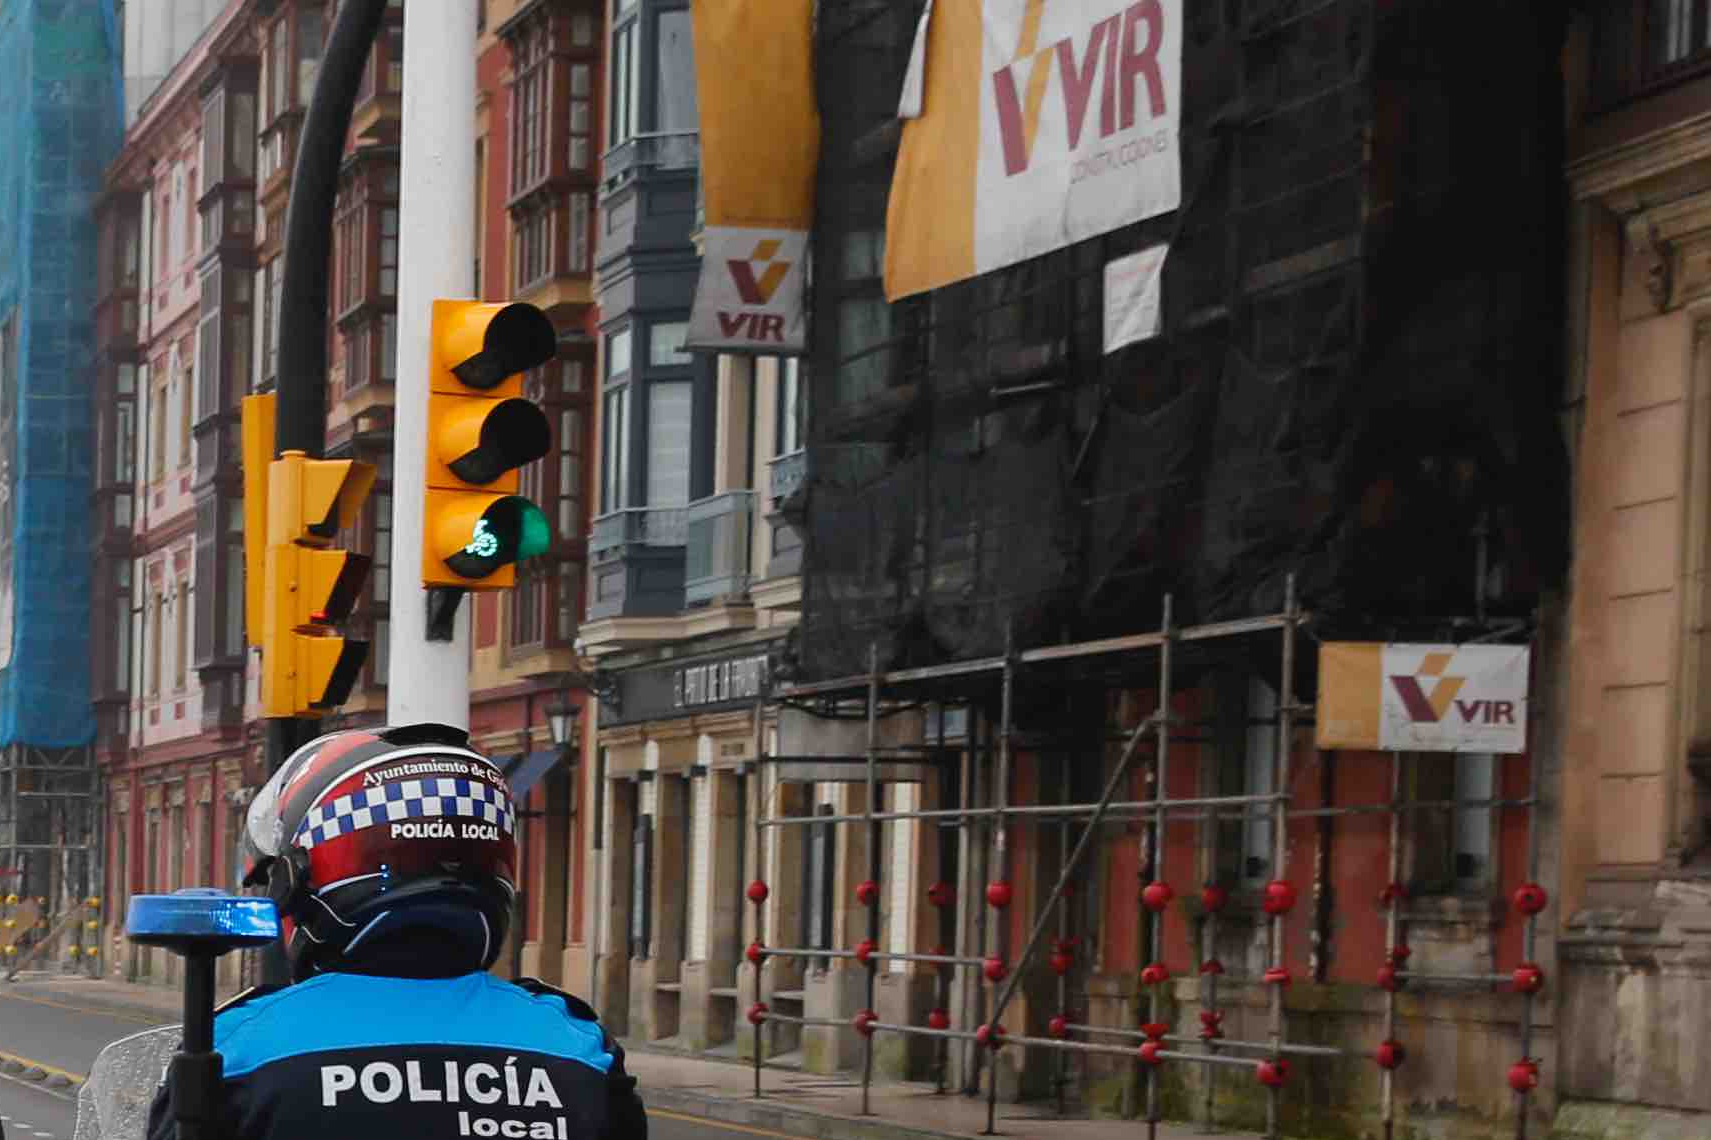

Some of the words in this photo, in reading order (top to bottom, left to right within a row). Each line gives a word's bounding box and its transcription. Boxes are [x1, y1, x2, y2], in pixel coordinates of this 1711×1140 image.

[1056, 0, 1166, 152] VIR
[717, 311, 785, 342] VIR
[1455, 700, 1515, 724] VIR
[362, 759, 469, 787] Ayuntamiento
[470, 763, 486, 778] de
[391, 818, 455, 839] POLICÍA
[461, 823, 500, 841] LOCAL
[321, 1056, 564, 1109] POLICÍA
[458, 1111, 569, 1140] local
